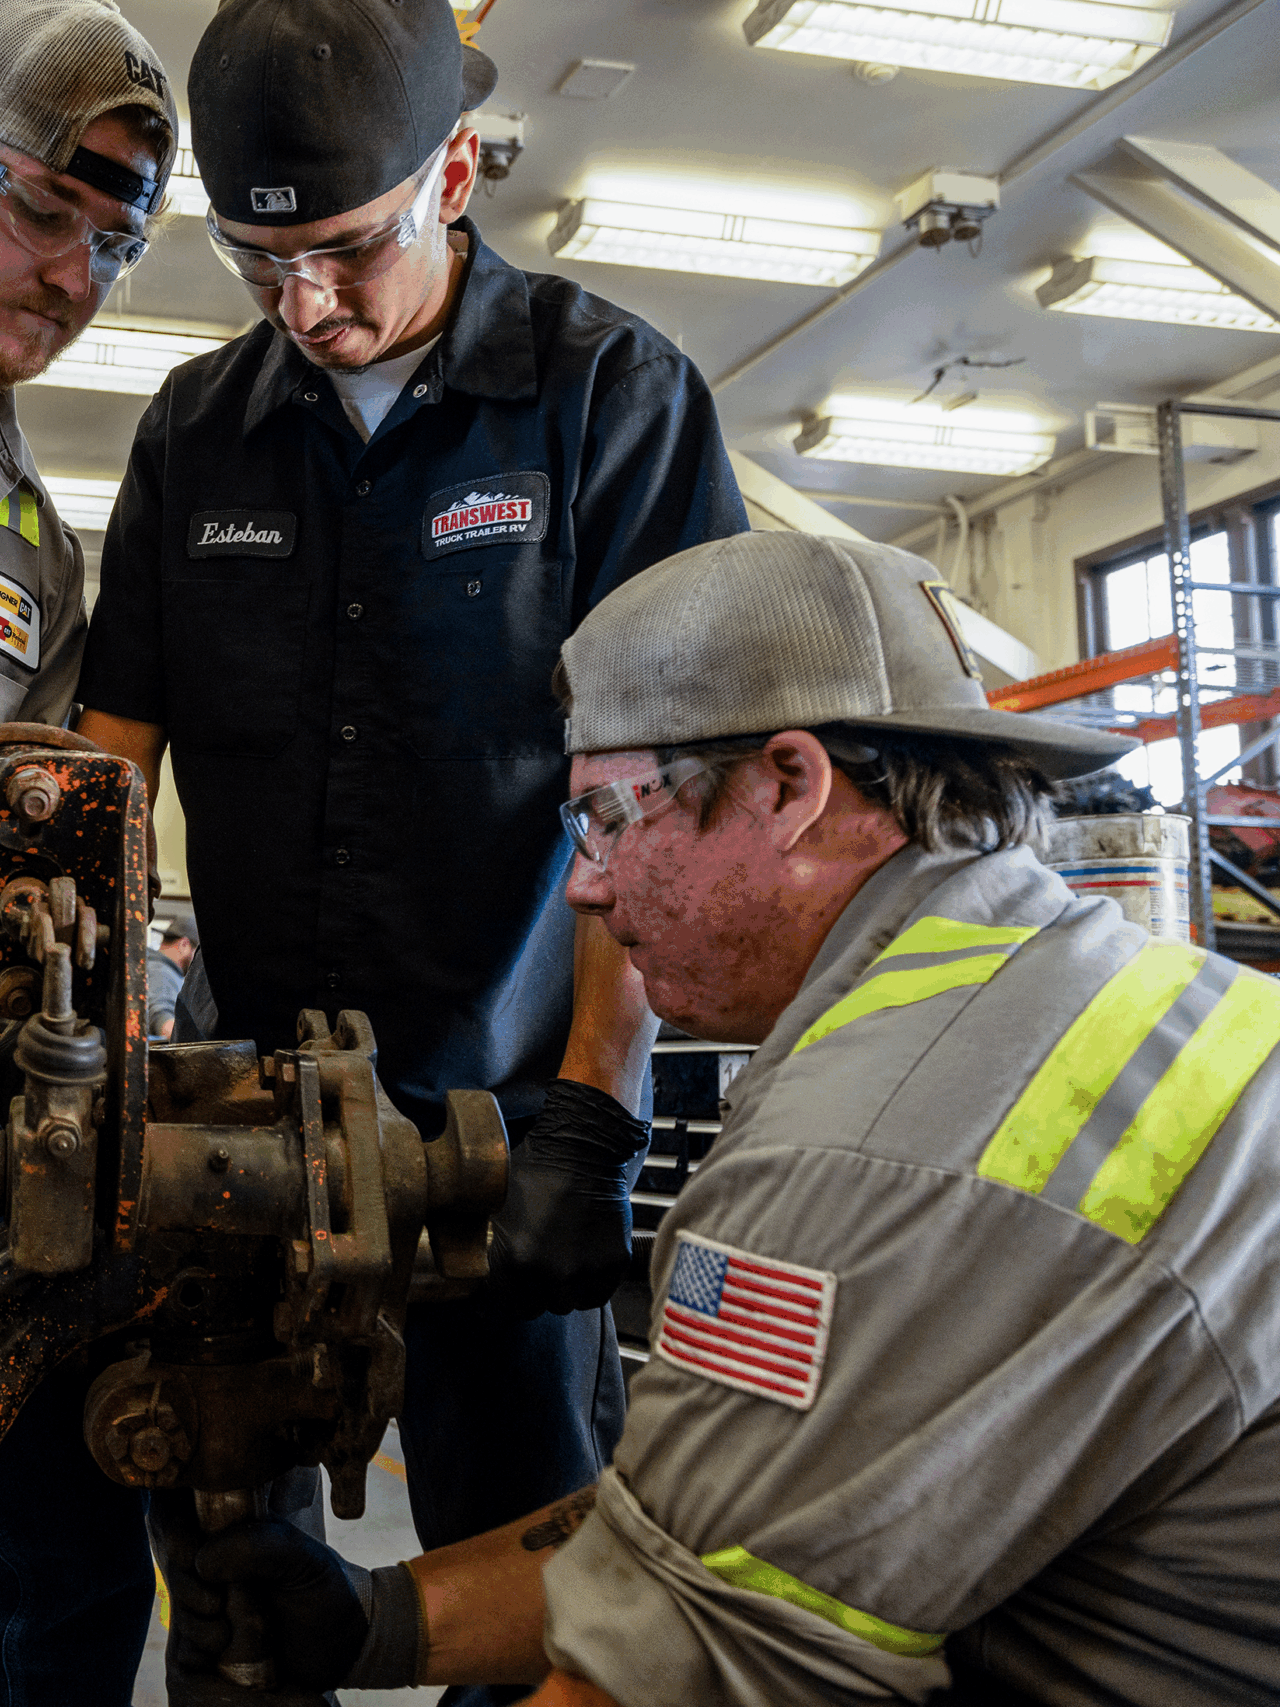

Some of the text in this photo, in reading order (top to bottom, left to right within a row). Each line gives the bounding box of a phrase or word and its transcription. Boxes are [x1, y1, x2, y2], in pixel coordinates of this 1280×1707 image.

[124, 50, 167, 100] CAT
[432, 501, 530, 536] TRANSWEST
[197, 521, 283, 545] Esteban
[434, 524, 527, 547] TRUCK TRAILER RV
[20, 601, 31, 619] CAT
